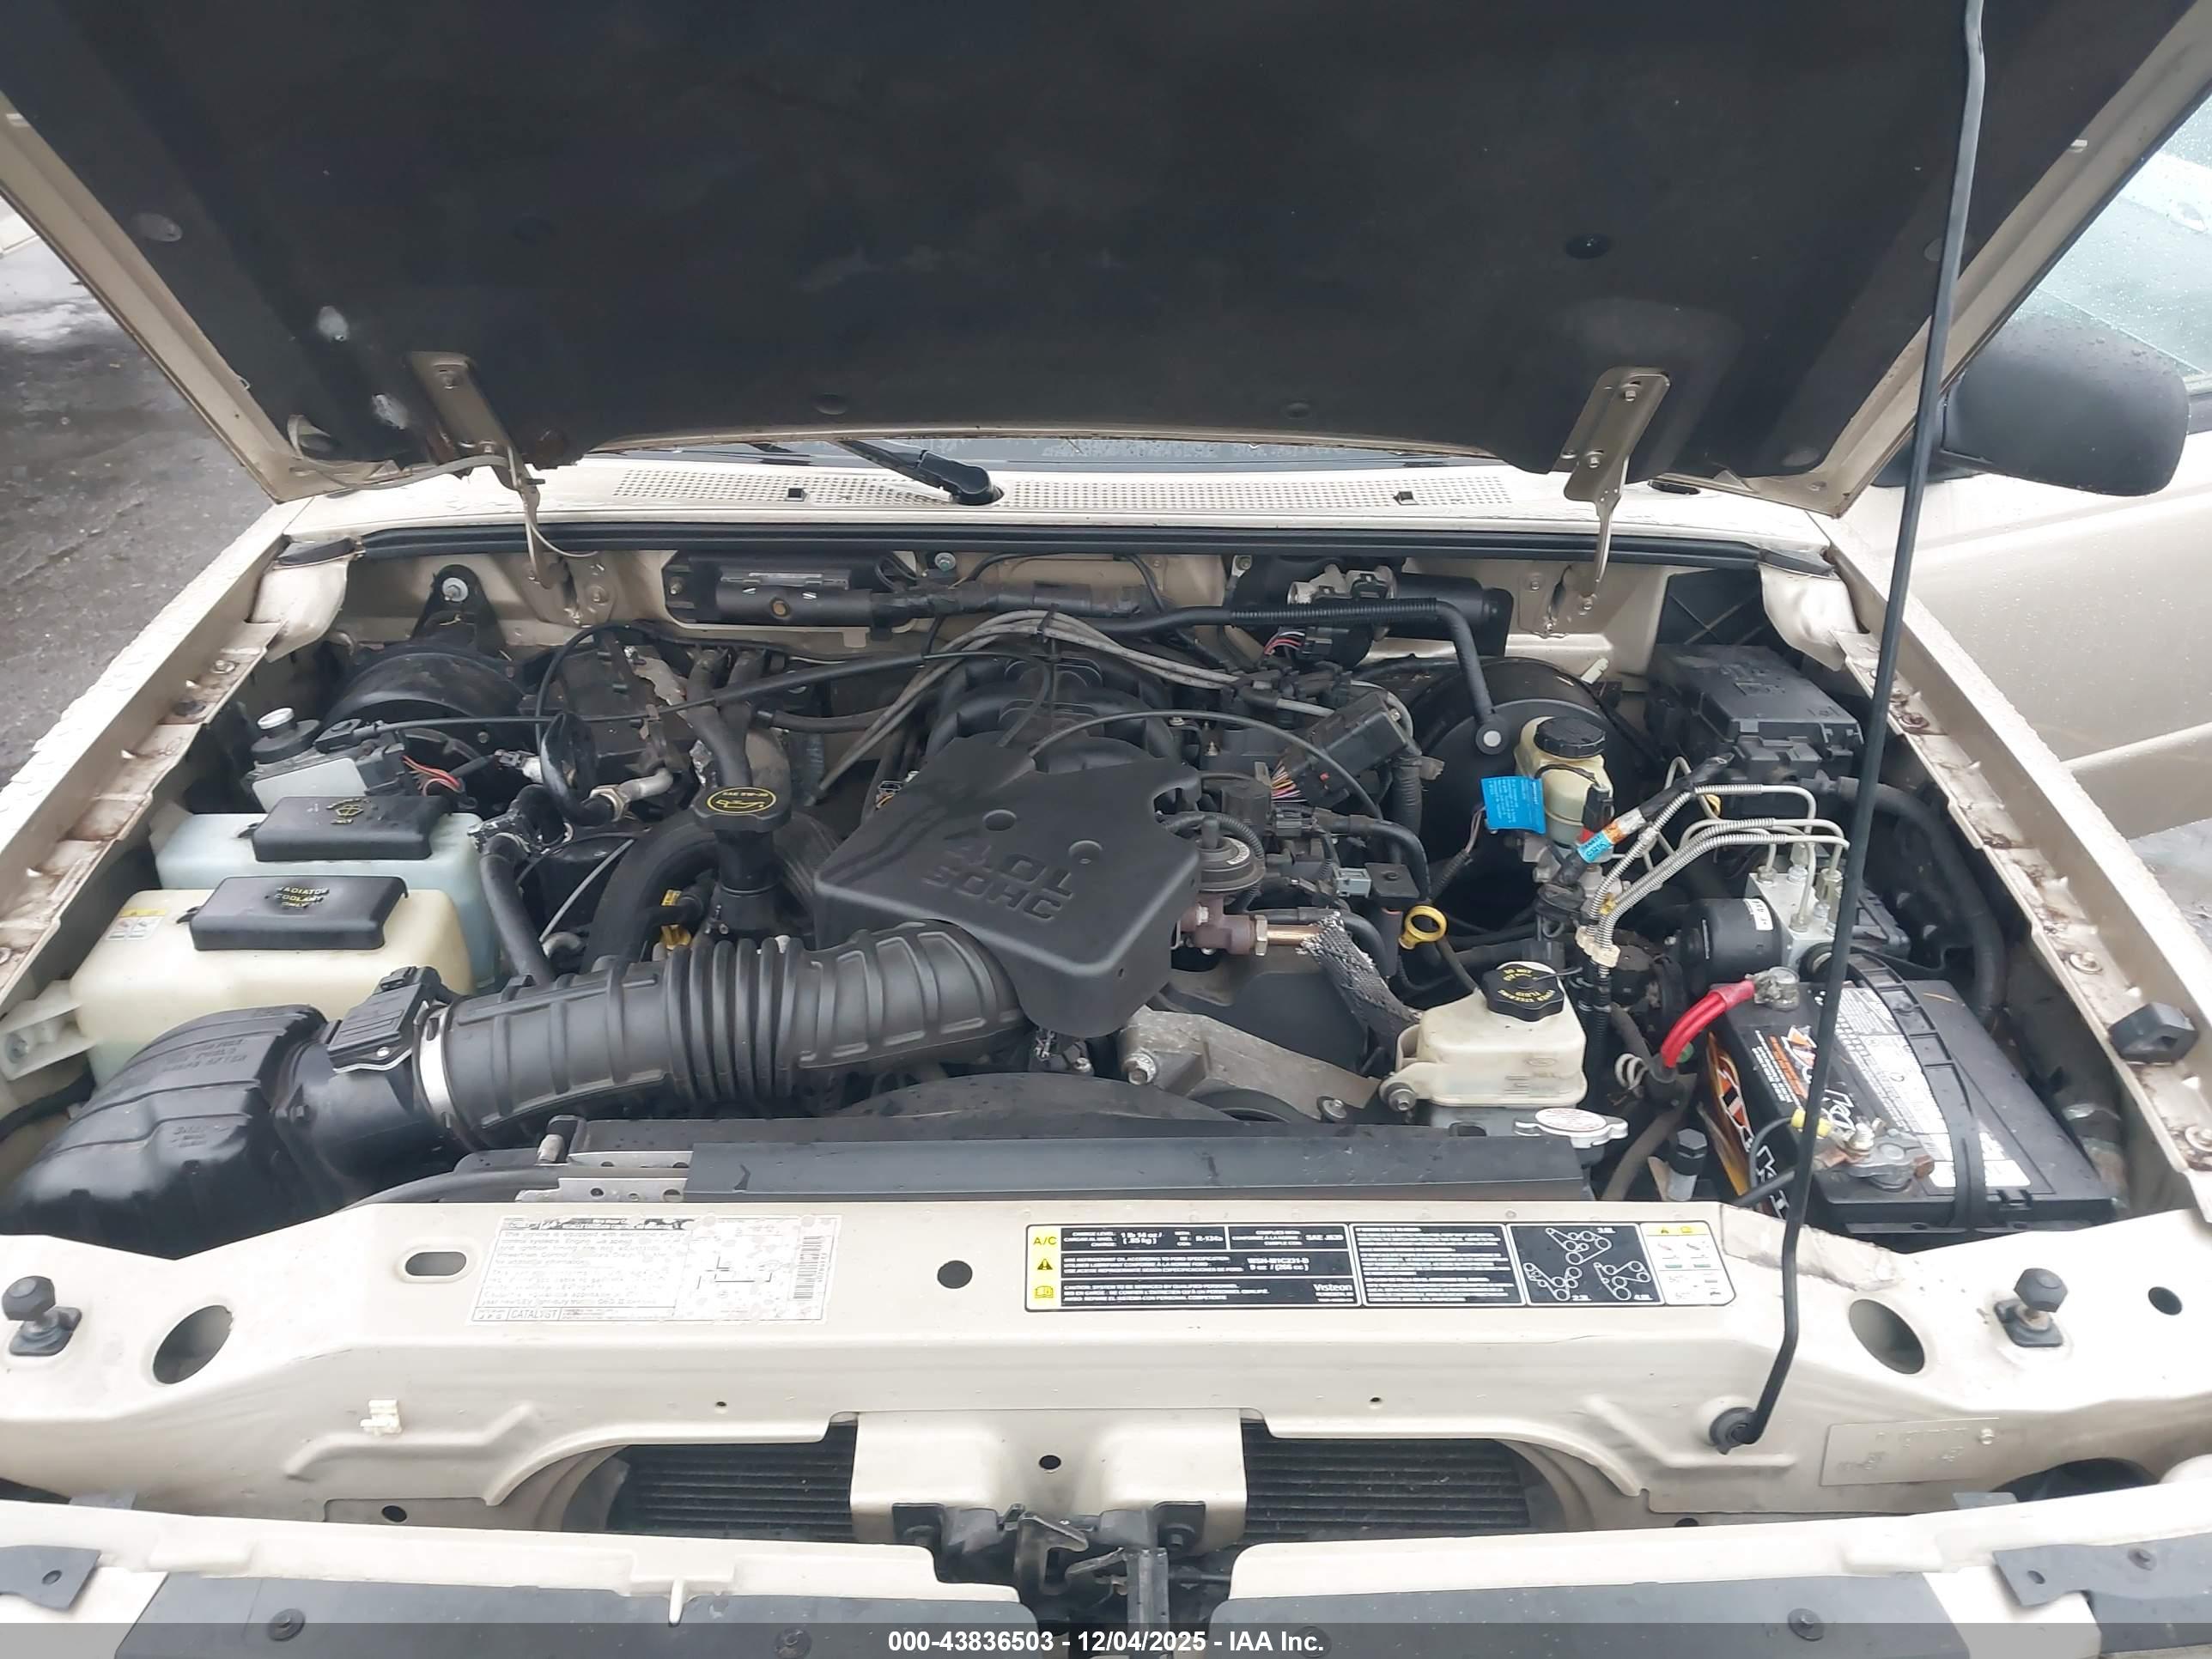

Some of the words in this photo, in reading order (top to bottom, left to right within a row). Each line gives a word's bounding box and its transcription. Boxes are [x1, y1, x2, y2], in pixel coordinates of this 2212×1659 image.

[274, 893, 324, 902] COOLANT
[1032, 1236, 1058, 1246] A/C
[510, 1309, 558, 1320] CATALYST
